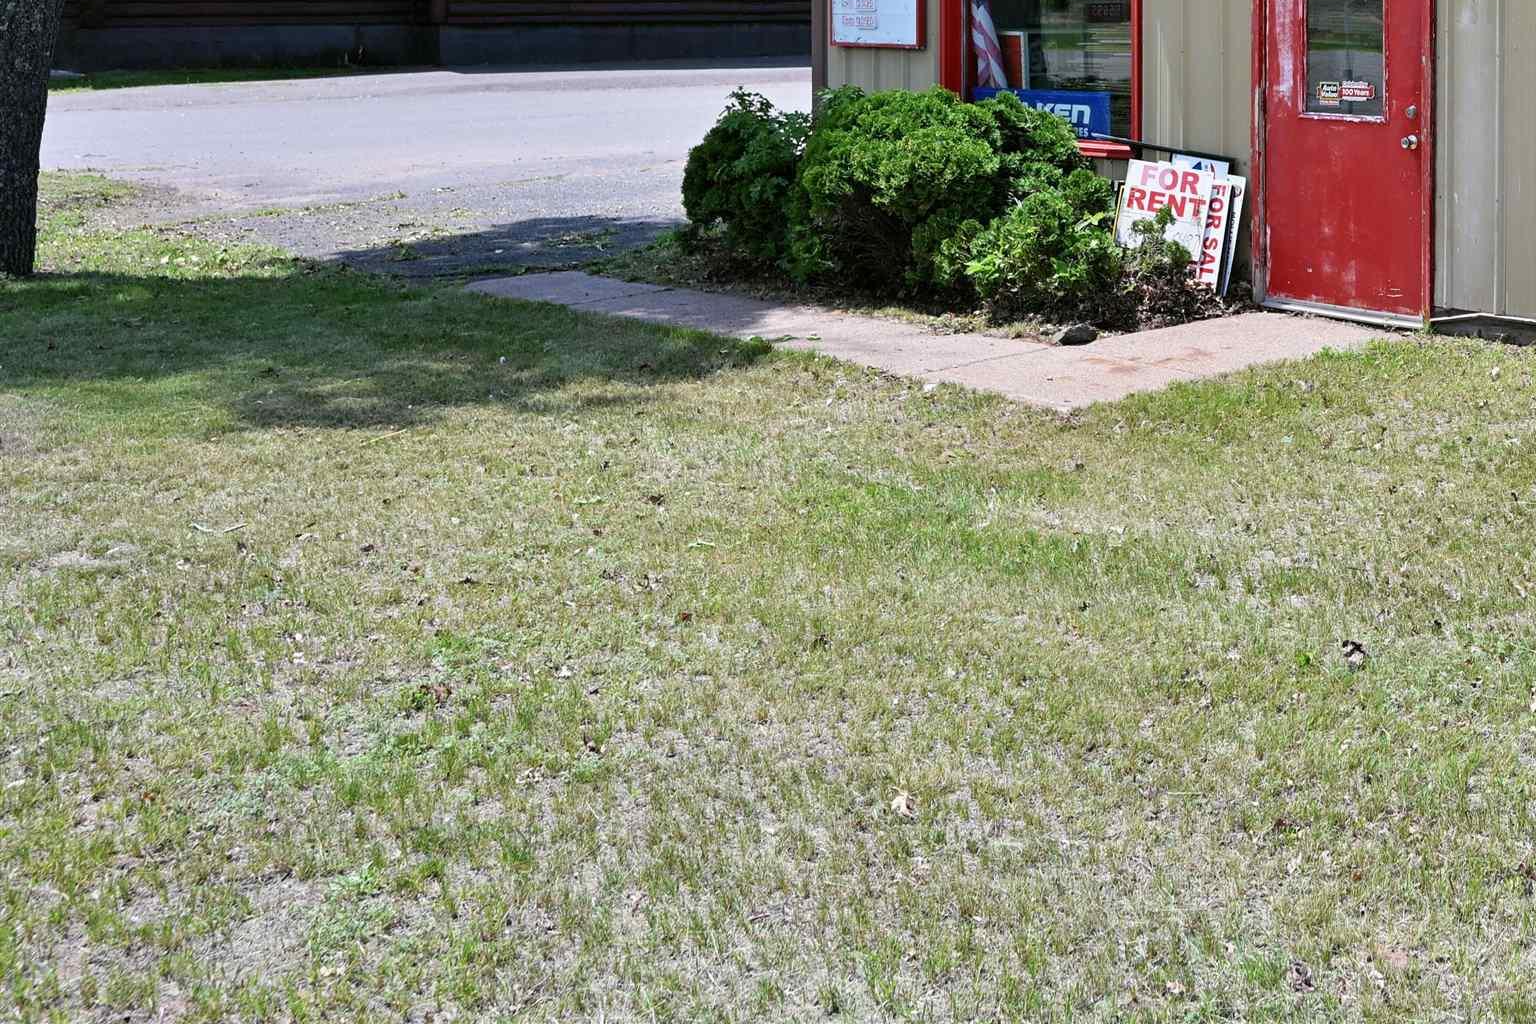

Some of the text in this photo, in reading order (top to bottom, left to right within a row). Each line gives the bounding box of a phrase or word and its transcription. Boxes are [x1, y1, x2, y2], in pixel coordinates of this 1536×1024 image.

[1354, 88, 1370, 96] Years
[1140, 164, 1200, 195] FOR
[1126, 187, 1206, 220] RENT
[1199, 184, 1226, 281] FOR SAL
